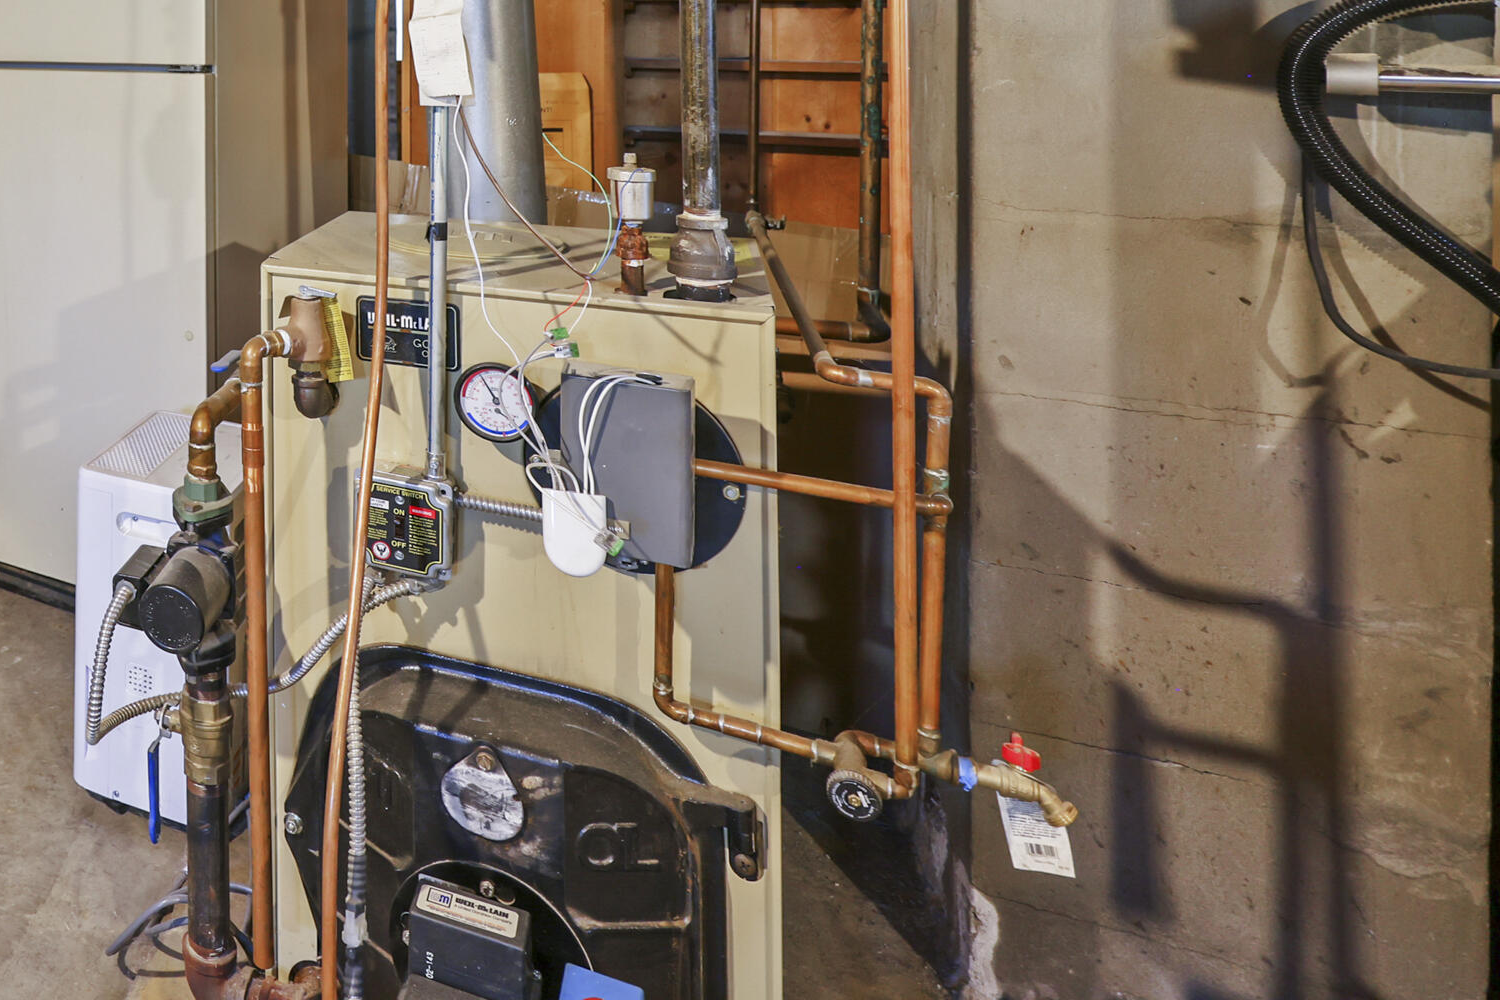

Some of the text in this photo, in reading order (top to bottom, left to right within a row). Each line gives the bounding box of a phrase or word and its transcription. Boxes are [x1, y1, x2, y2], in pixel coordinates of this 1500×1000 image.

[376, 485, 400, 496] SERVICE
[393, 507, 405, 516] ON
[391, 539, 407, 549] OFF
